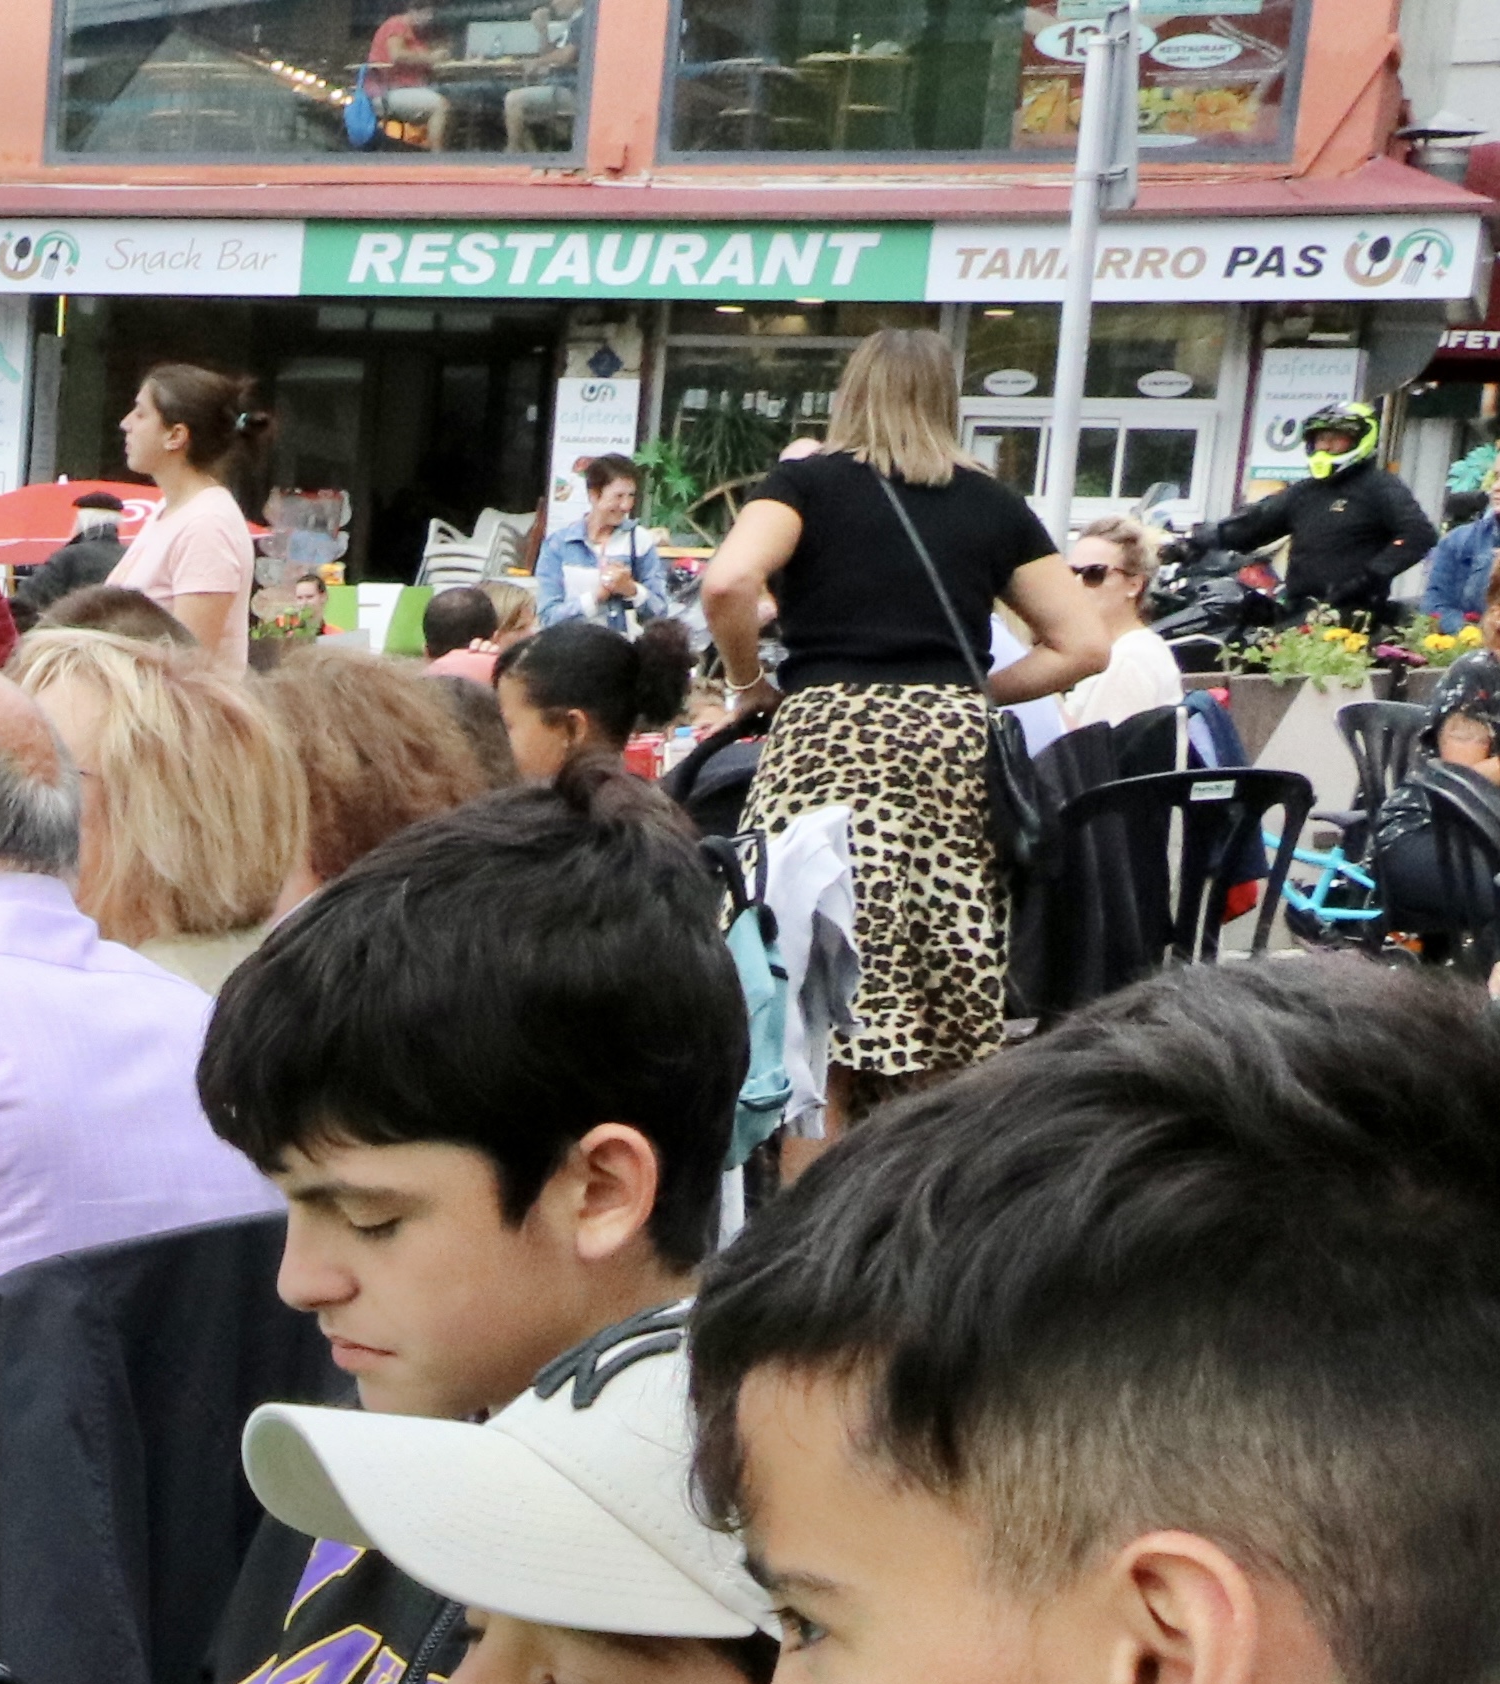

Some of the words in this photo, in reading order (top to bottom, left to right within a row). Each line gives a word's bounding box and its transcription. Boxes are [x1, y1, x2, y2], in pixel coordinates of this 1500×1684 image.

[105, 237, 203, 275] Snack
[216, 239, 278, 273] Bar
[347, 232, 881, 286] RESTAURANT
[955, 246, 1207, 281] TAMRRO
[1223, 244, 1327, 281] PAS
